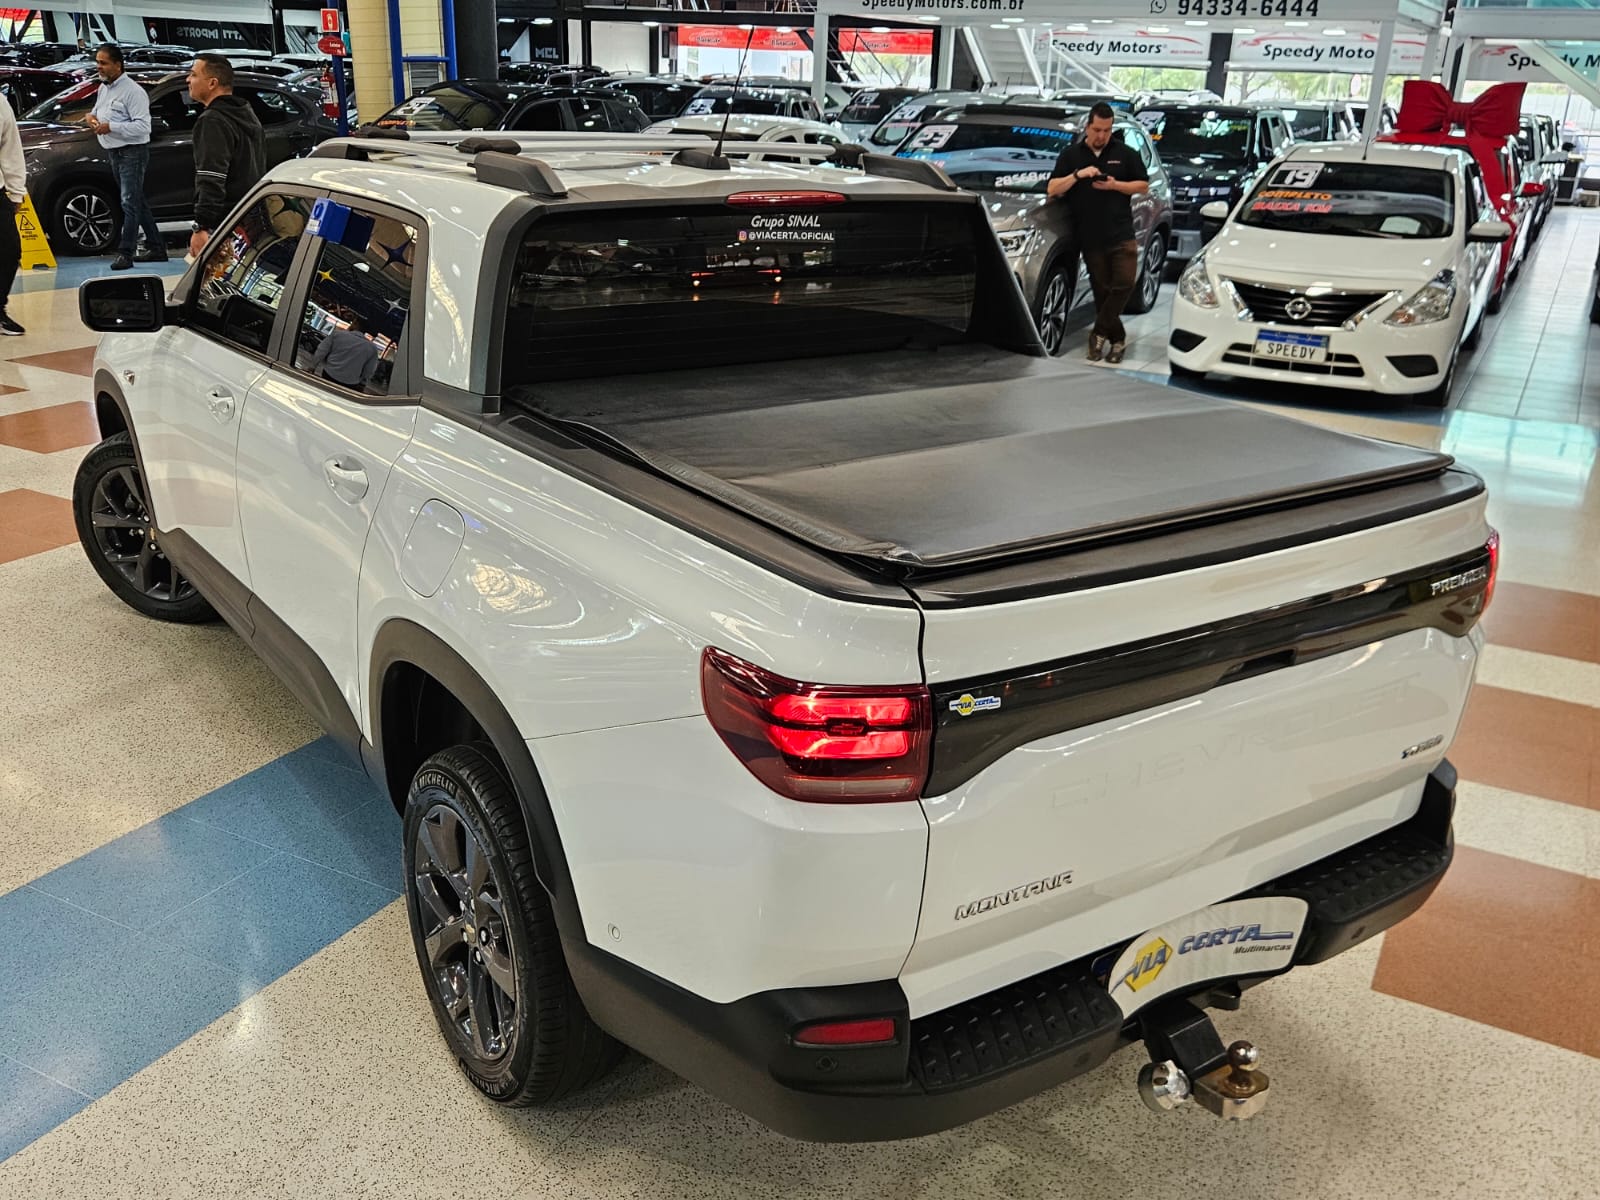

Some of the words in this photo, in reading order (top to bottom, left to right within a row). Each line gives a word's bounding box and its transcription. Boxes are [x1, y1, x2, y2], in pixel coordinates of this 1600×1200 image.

[1177, 0, 1318, 17] 94334-6444
[1107, 41, 1163, 54] Motors
[1263, 44, 1325, 62] Speedy
[1283, 168, 1318, 186] 19
[1258, 190, 1332, 201] COMPLETO
[751, 215, 785, 231] Grupo
[786, 215, 821, 227] SINAL
[748, 231, 835, 241] @VIACERTA.OFICIAL
[1267, 342, 1317, 361] SPEEDY
[418, 773, 456, 795] MICHELIN
[954, 870, 1074, 921] MONTANA
[1233, 943, 1293, 955] Multimarcas
[1131, 943, 1168, 982] VIA
